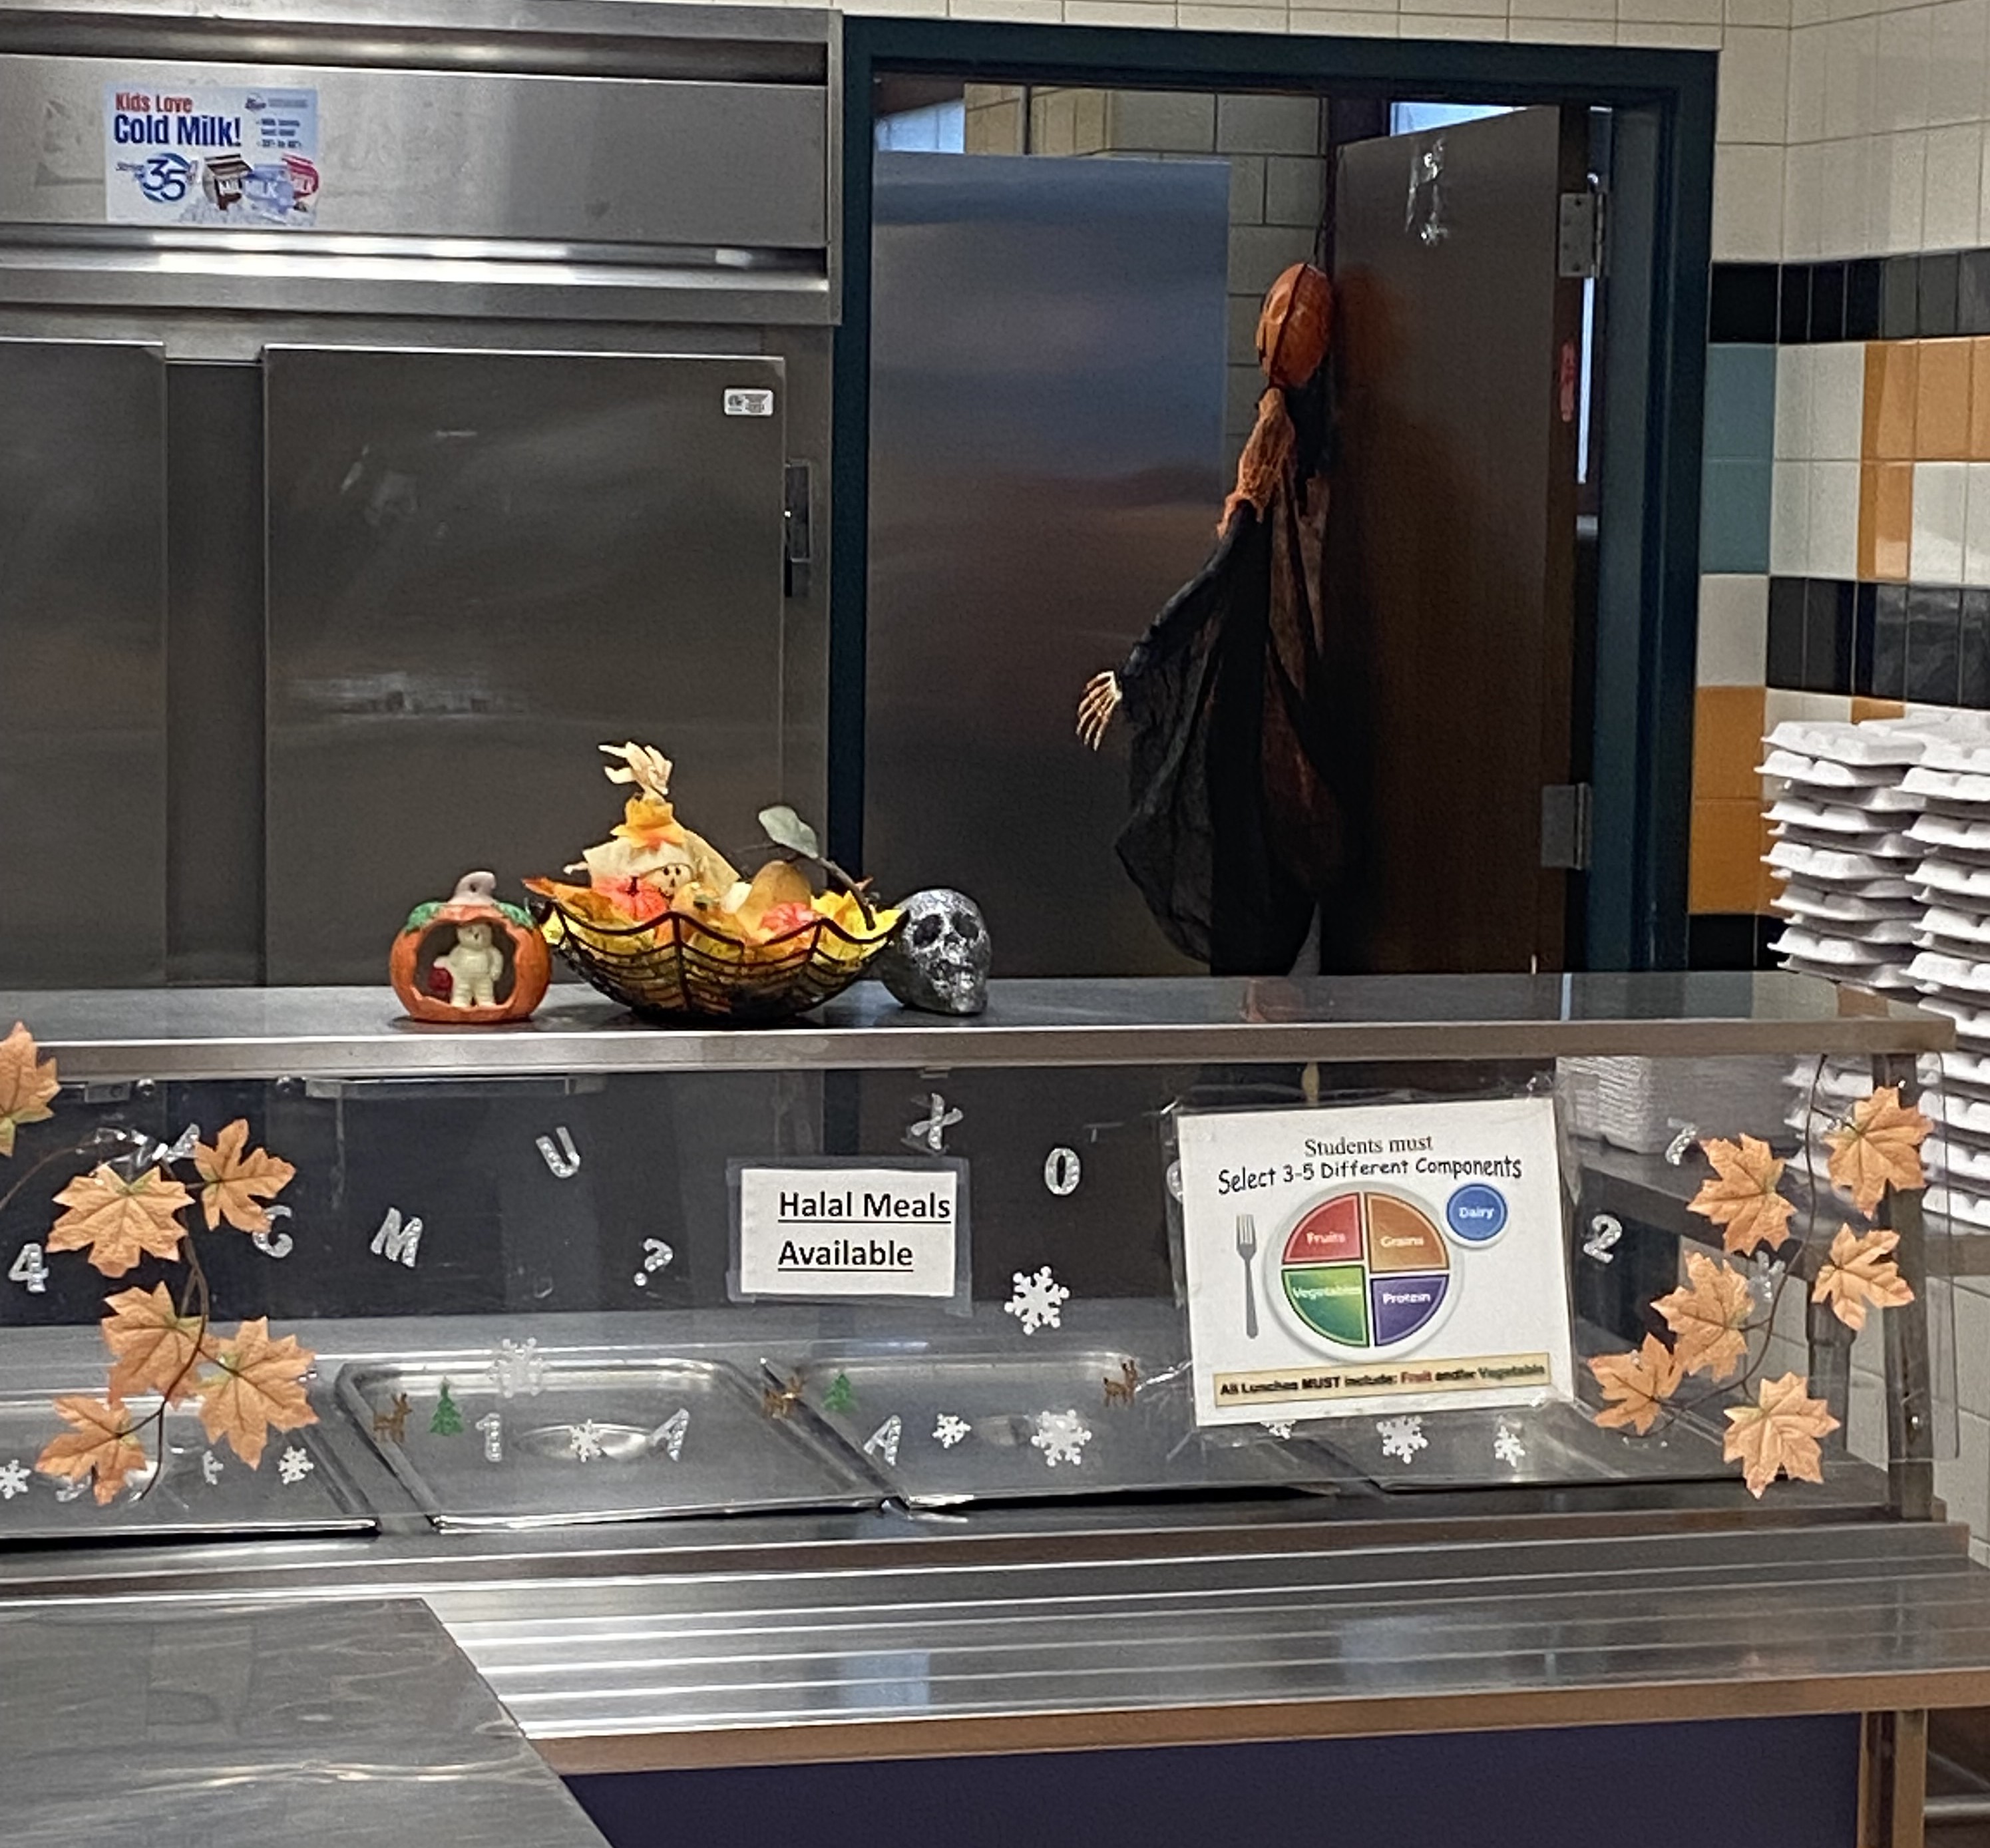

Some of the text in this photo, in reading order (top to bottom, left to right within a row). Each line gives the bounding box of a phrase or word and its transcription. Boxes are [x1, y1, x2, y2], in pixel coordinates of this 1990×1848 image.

[115, 92, 193, 114] Kids Love
[114, 114, 242, 147] Cold Milk!
[142, 158, 187, 202] 35
[535, 1127, 580, 1179] U
[1304, 1135, 1433, 1157] Students must
[1218, 1155, 1522, 1195] Select 3-5 Different Components
[779, 1191, 951, 1218] Halal Meals
[1458, 1206, 1495, 1220] Dairy
[370, 1206, 423, 1267] M
[1306, 1231, 1346, 1245] Fruits
[1380, 1236, 1425, 1248] Grains
[1583, 1214, 1623, 1264] 2
[777, 1240, 914, 1266] Available
[8, 1242, 49, 1293] 4
[1382, 1292, 1431, 1305] Protein
[1301, 1376, 1341, 1389] MUST
[1400, 1370, 1432, 1384] Fruit
